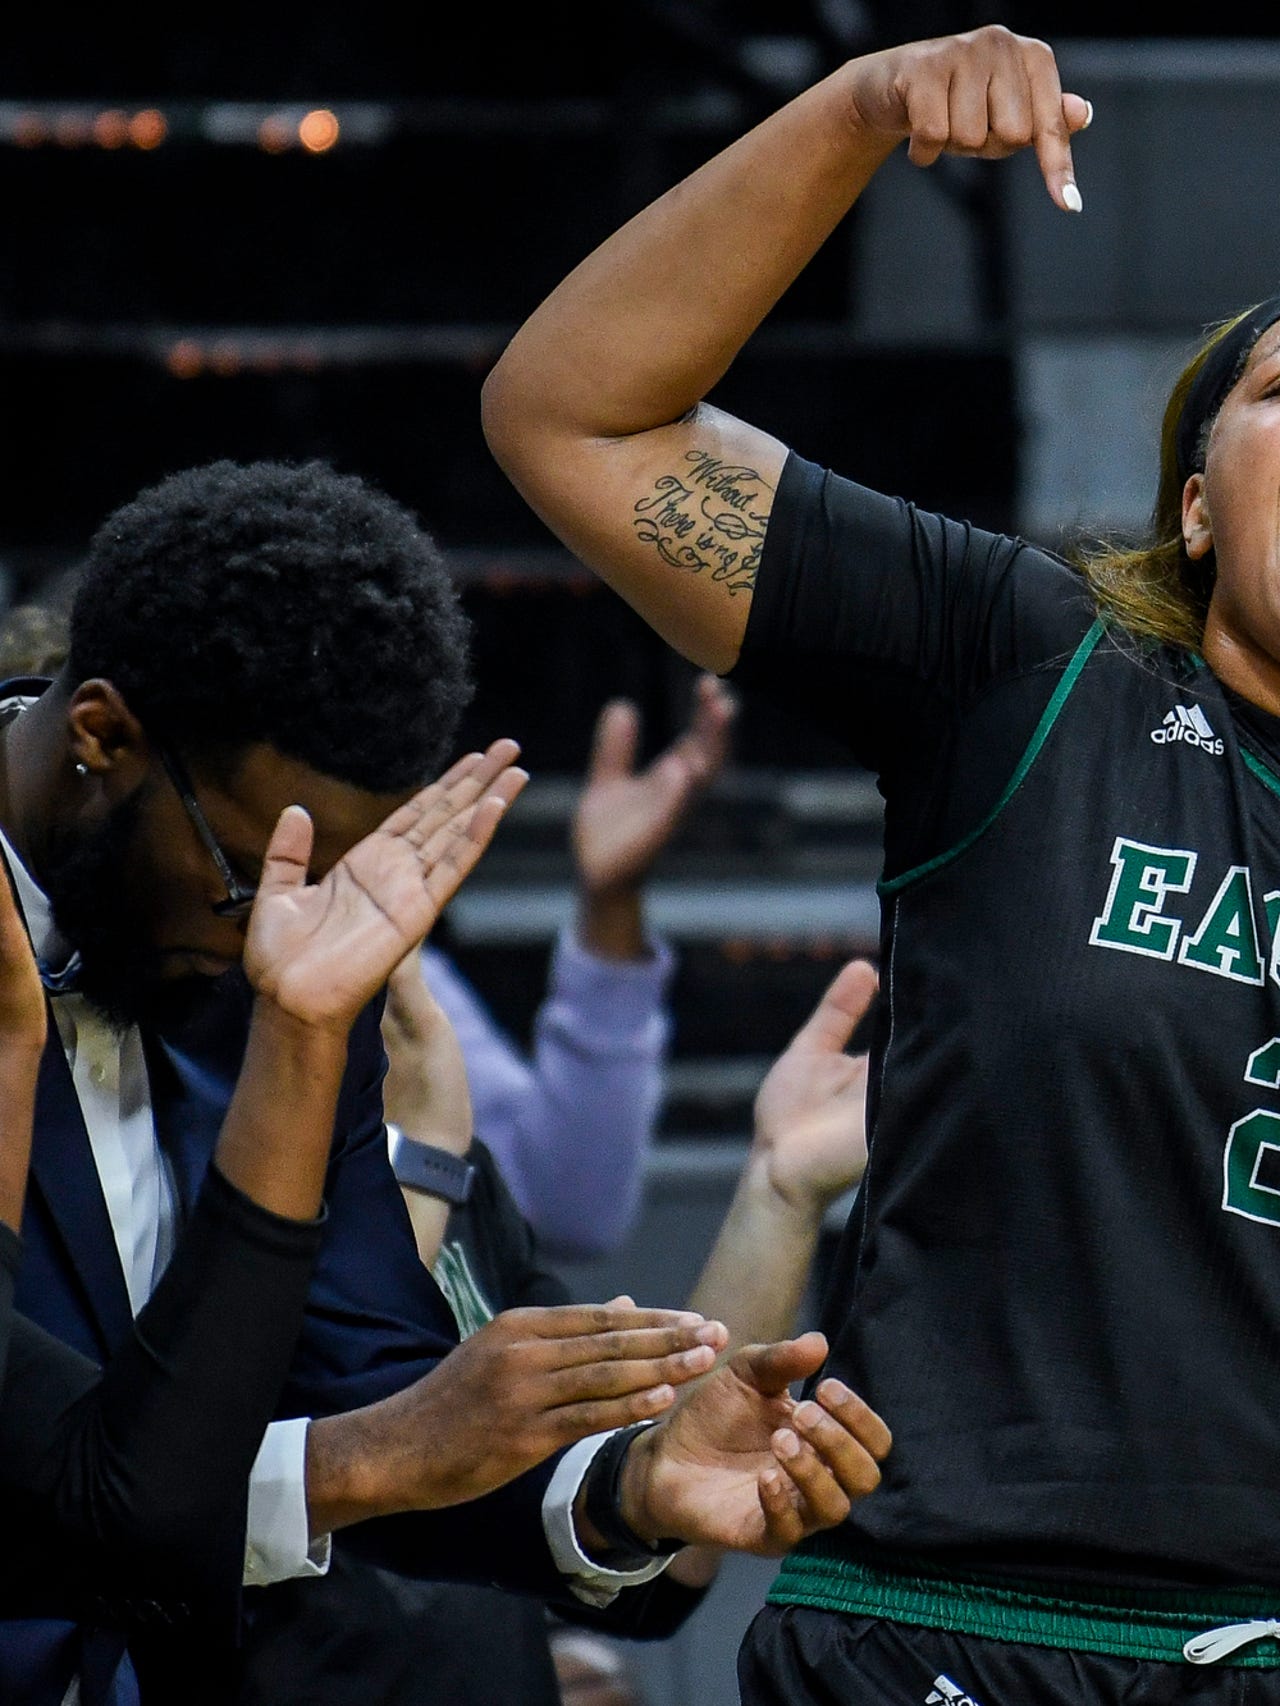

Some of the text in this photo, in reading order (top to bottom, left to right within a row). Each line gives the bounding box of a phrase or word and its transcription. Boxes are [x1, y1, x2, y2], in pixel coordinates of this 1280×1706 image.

[634, 475, 696, 540] There
[685, 450, 768, 512] Without
[1150, 720, 1225, 756] adidas
